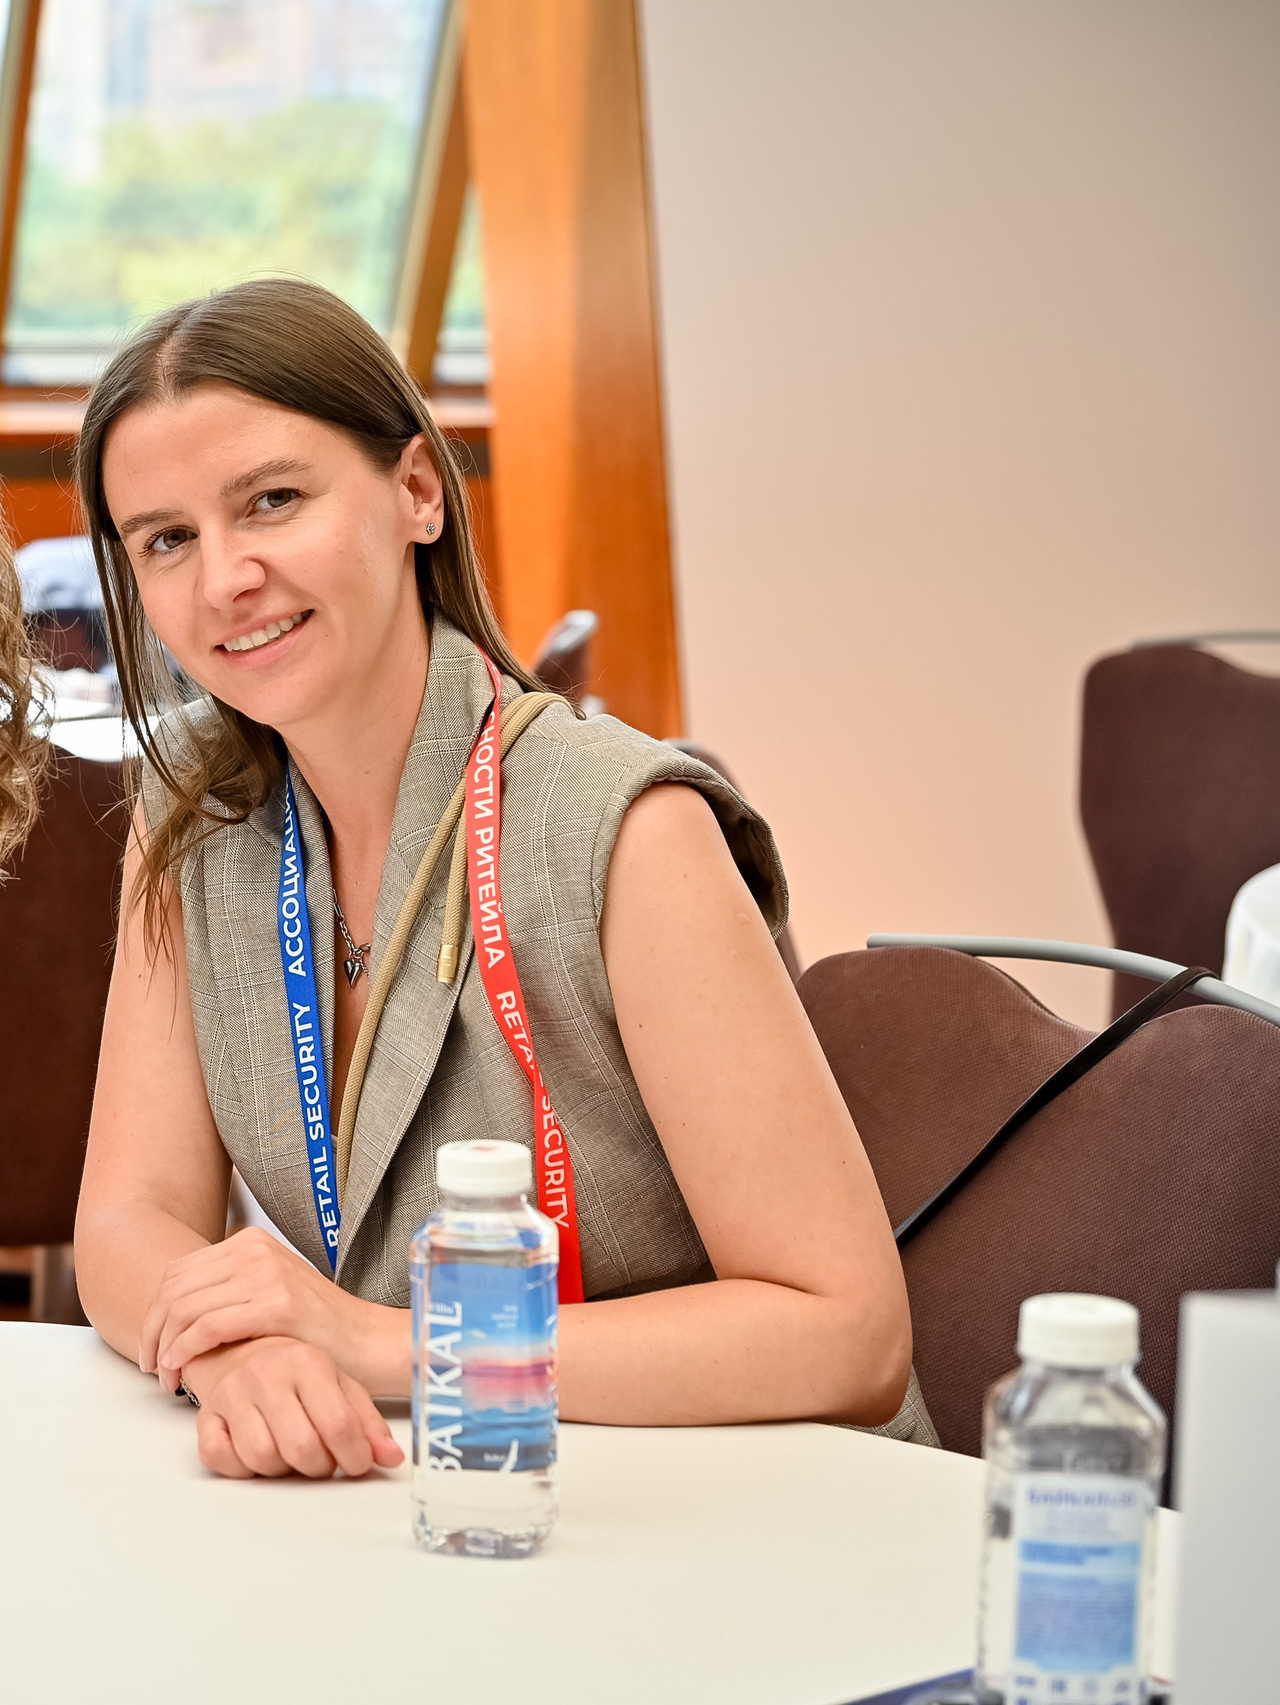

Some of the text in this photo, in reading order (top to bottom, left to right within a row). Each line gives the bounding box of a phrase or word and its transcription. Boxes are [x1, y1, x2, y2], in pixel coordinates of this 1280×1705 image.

[468, 829, 506, 970] РИТЕЙЛА
[289, 1003, 338, 1249] RETAIL SECURITY
[496, 990, 570, 1228] RETA SECURITY
[424, 1301, 463, 1471] BAIKAL
